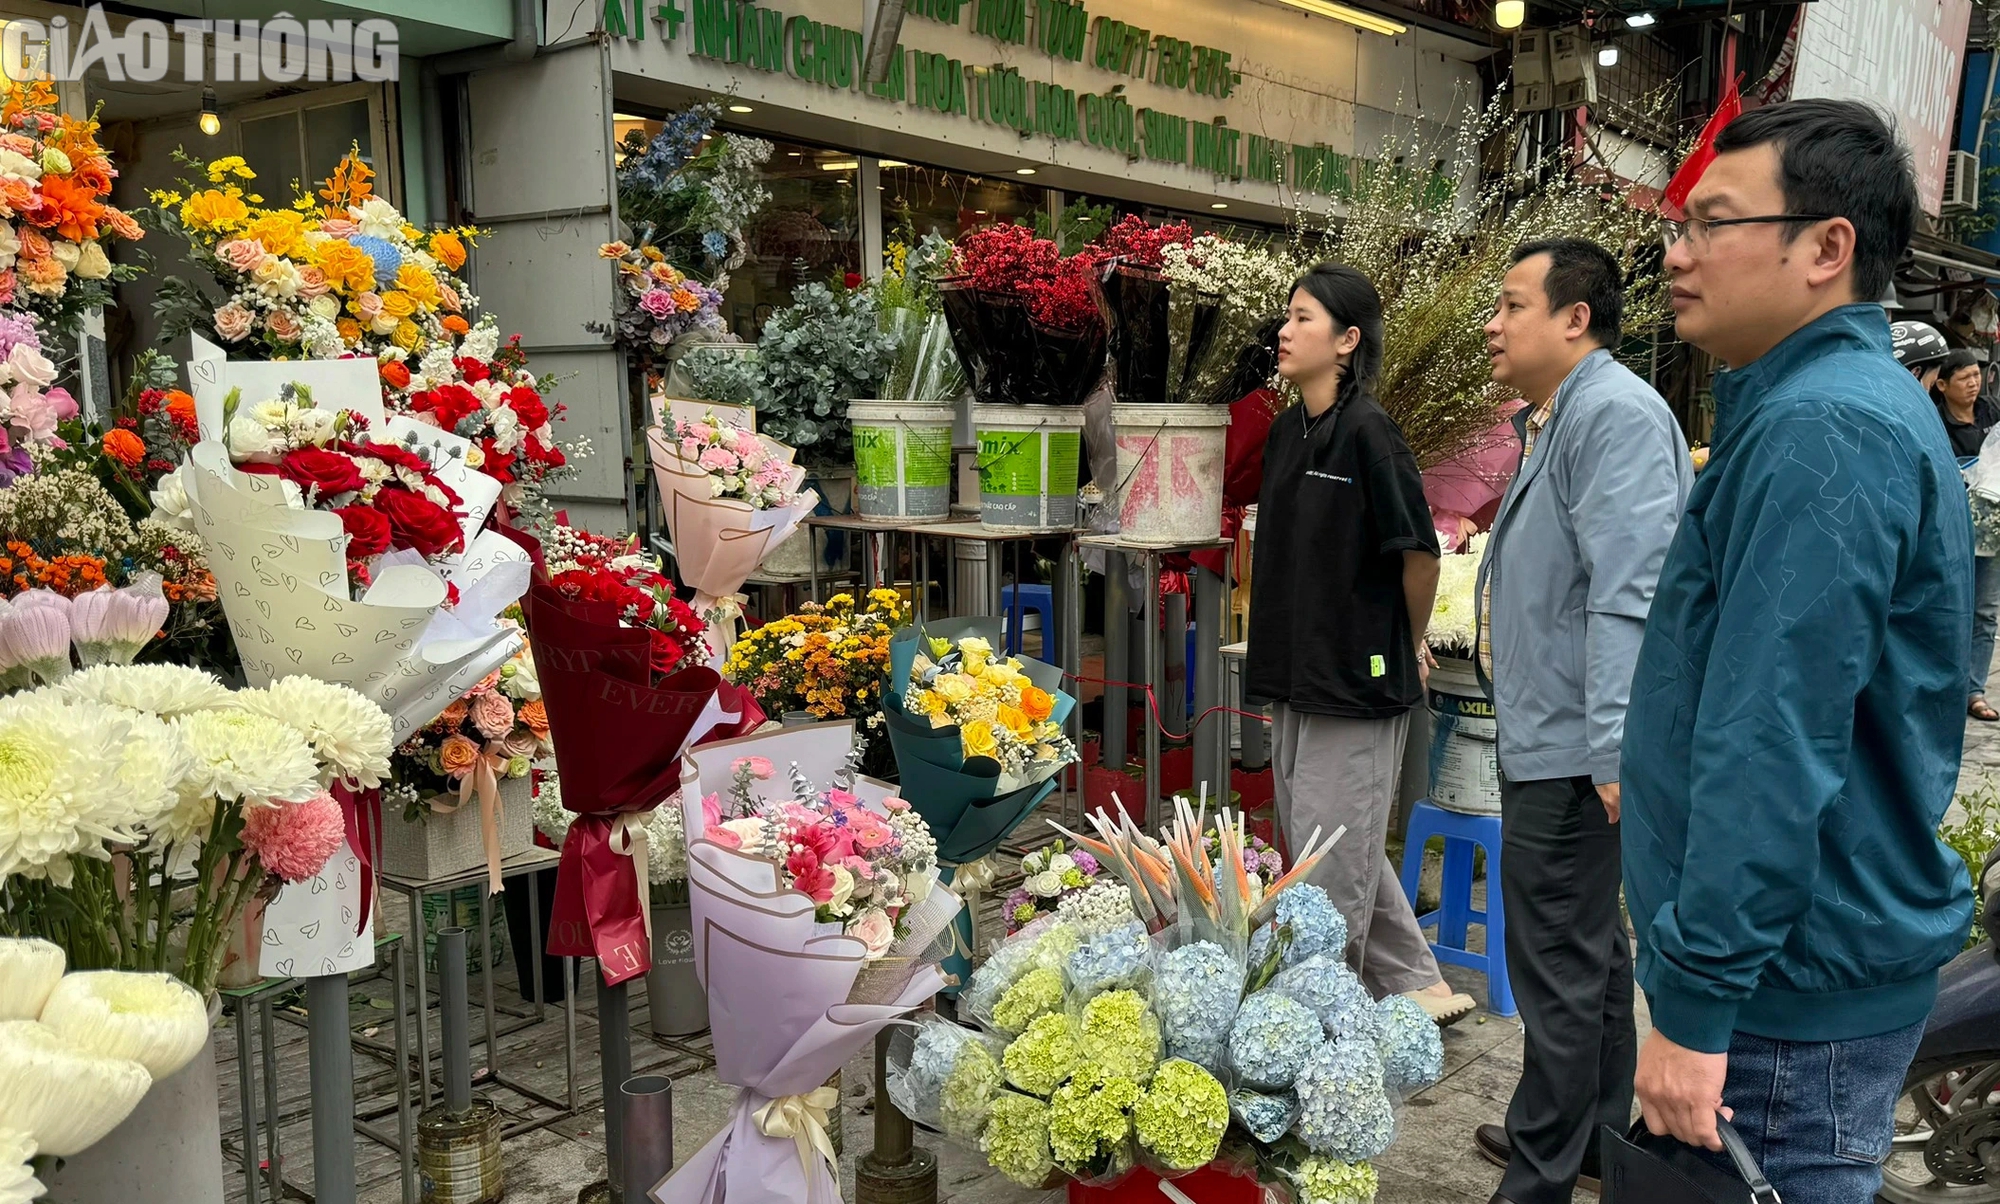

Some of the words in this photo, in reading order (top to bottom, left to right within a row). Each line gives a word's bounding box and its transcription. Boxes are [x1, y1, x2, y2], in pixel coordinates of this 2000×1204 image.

[787, 14, 905, 101] CHUYN
[911, 49, 966, 116] HOA
[1031, 81, 1079, 139] HOA
[1139, 108, 1187, 164] SINH
